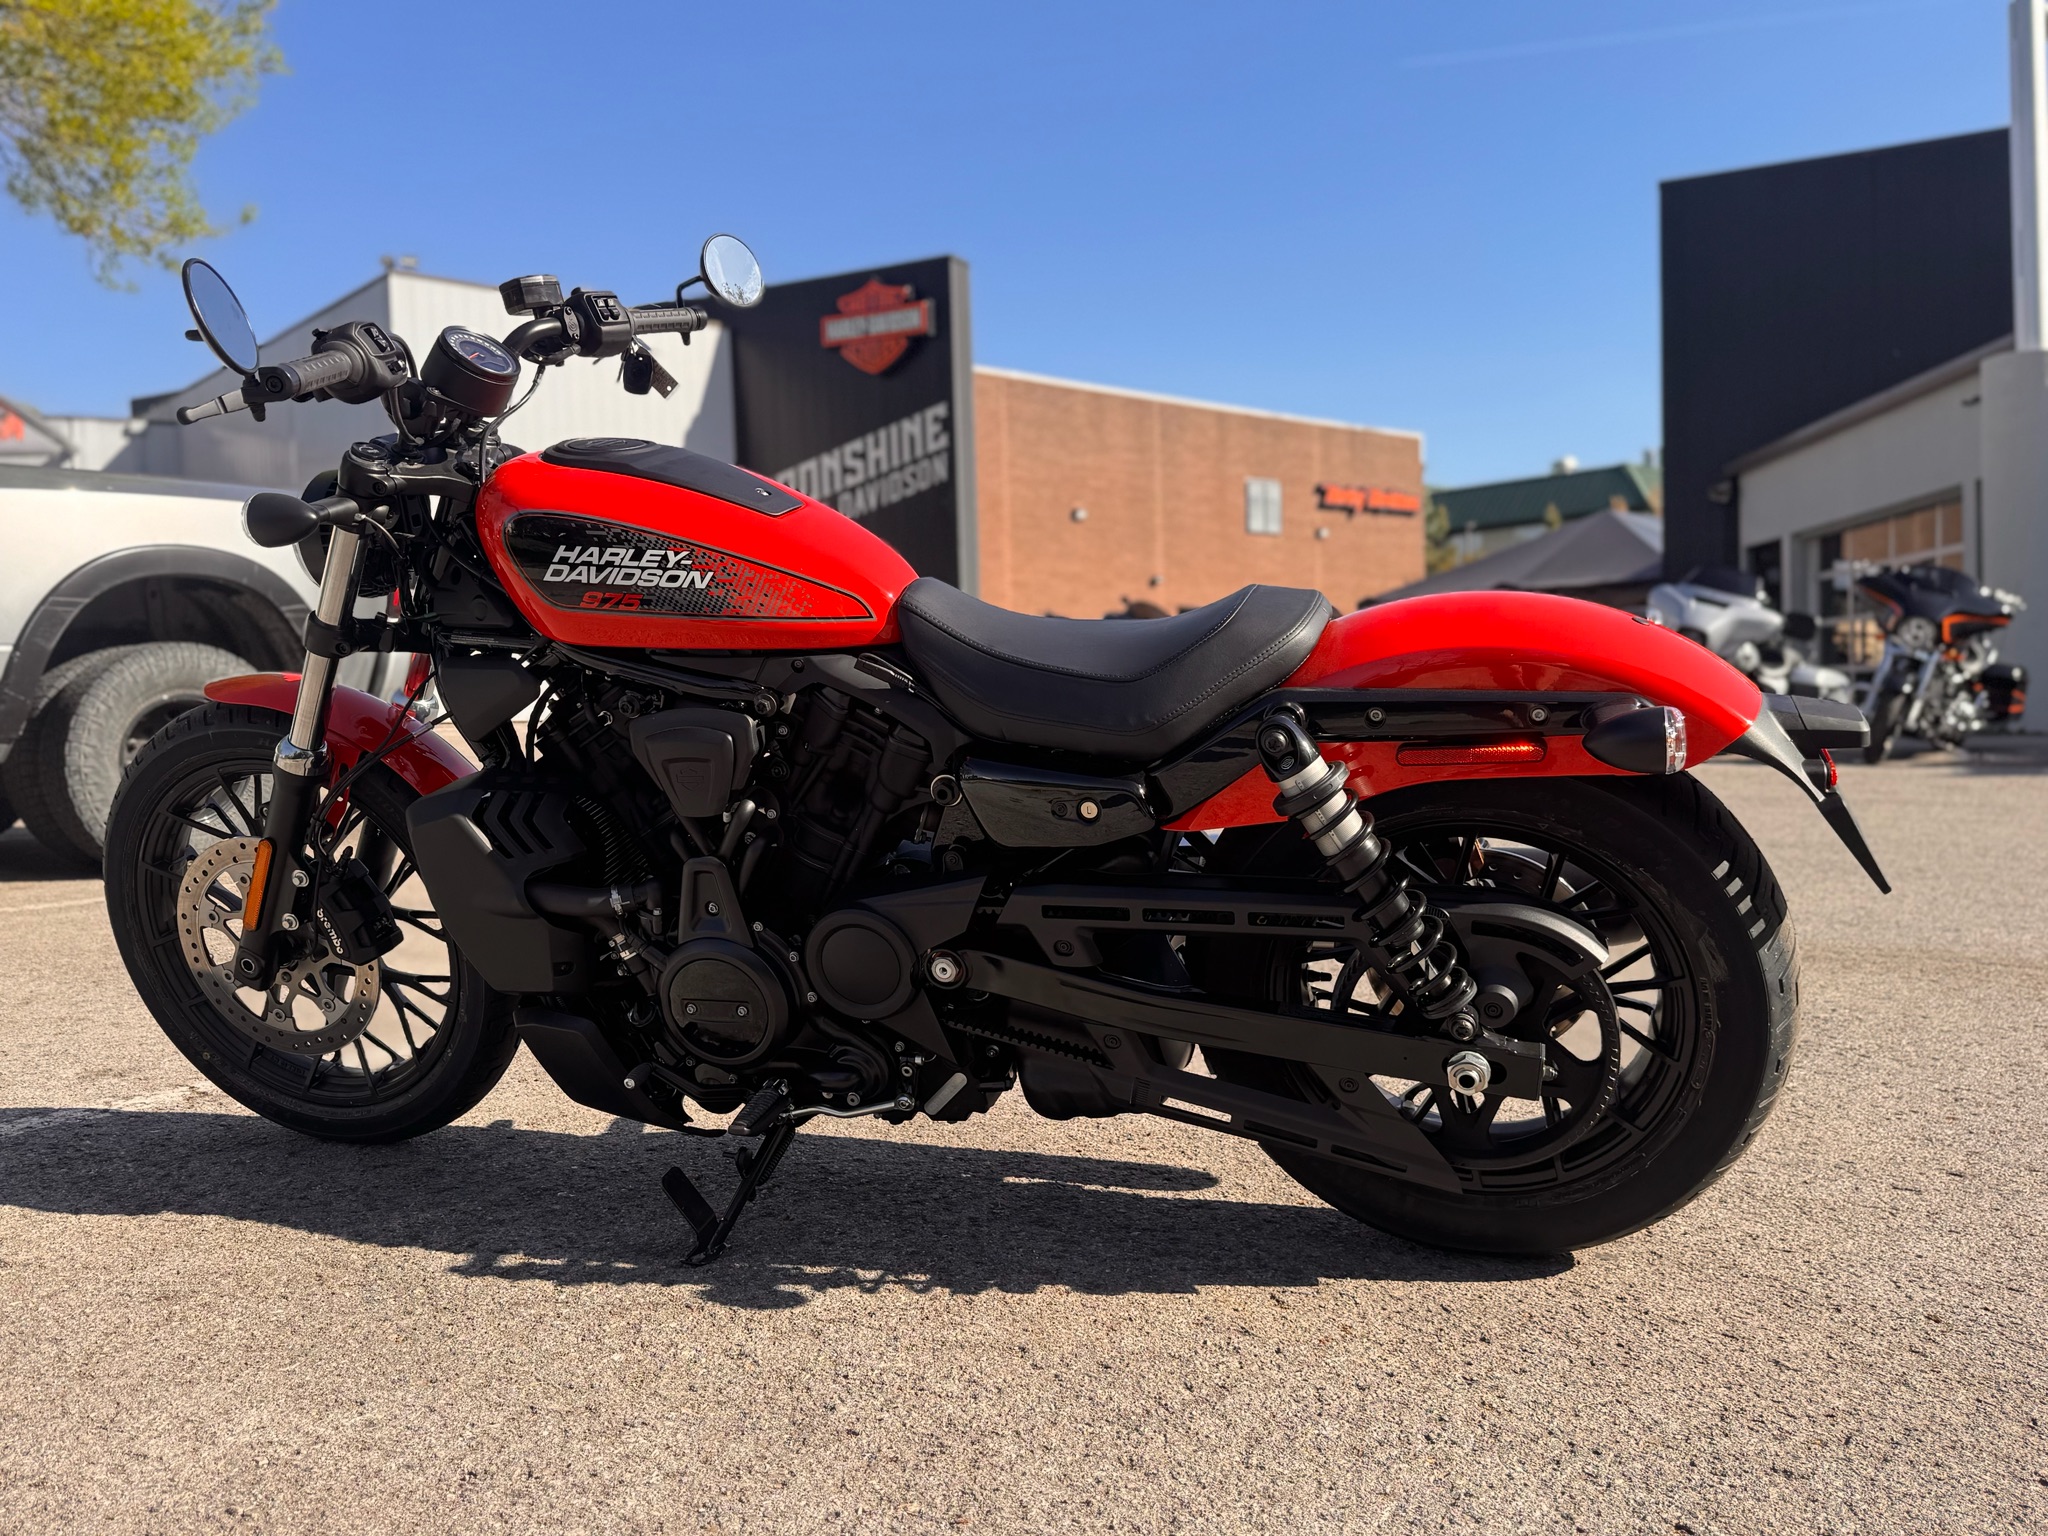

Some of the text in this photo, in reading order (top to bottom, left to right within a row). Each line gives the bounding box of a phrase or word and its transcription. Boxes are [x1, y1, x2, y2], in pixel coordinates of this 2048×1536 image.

[552, 545, 692, 568] HARLEY-
[543, 564, 714, 588] DAVIDSON
[580, 592, 643, 610] 975
[317, 908, 343, 954] brembo
